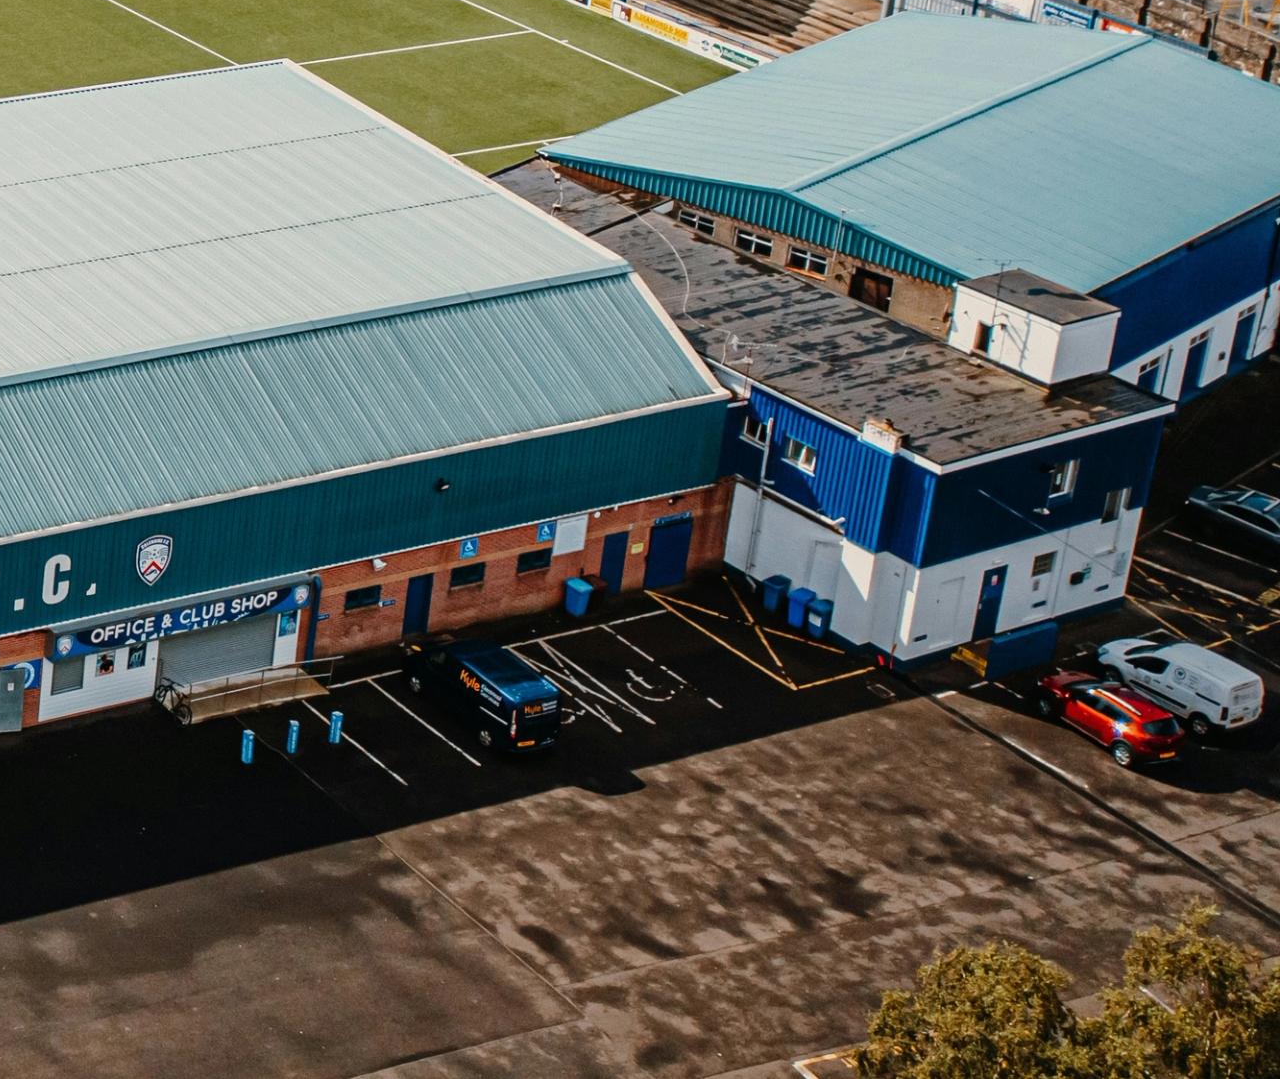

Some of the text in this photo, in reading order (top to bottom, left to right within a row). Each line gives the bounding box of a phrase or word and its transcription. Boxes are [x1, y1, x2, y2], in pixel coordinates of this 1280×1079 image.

[90, 617, 156, 644] OFFICE
[161, 613, 173, 629] &
[179, 599, 225, 625] CLUB
[230, 590, 279, 615] SHOP
[459, 669, 481, 693] Kyle
[524, 704, 542, 716] Kyle
